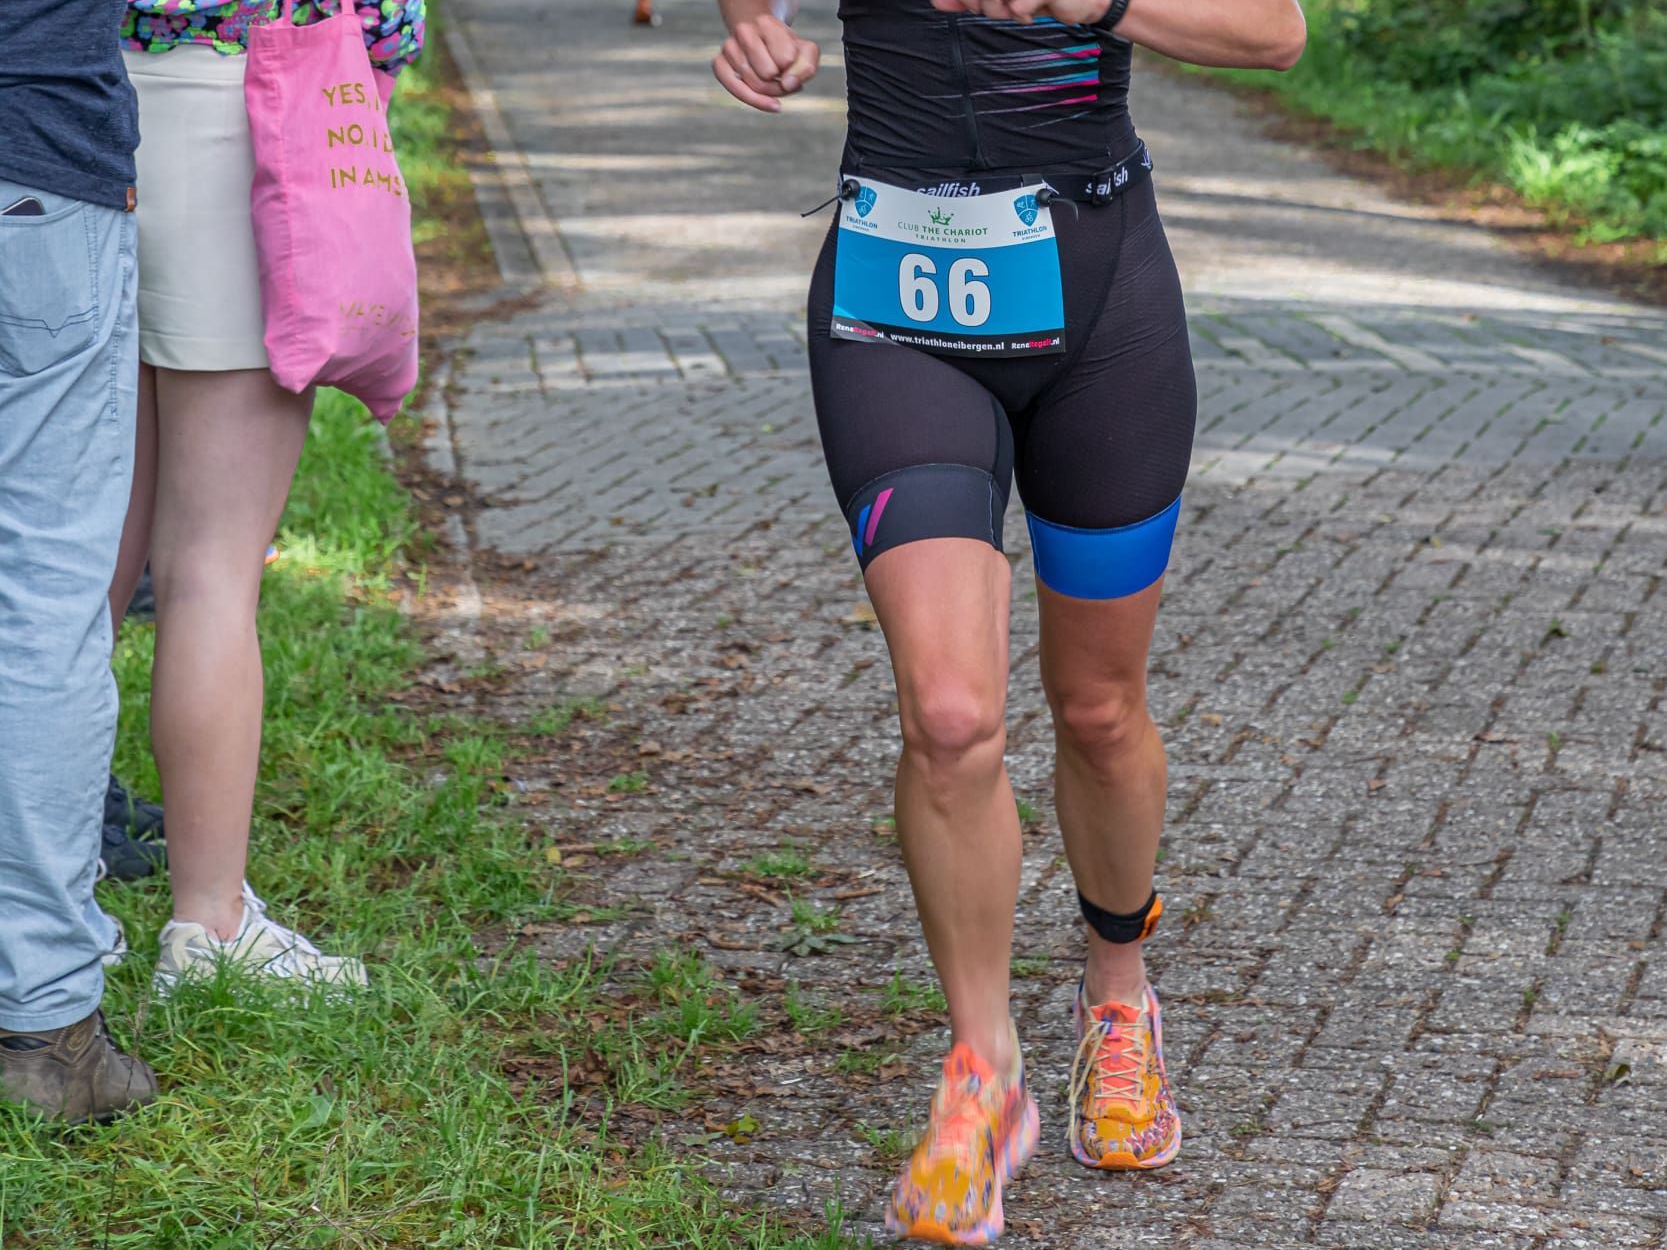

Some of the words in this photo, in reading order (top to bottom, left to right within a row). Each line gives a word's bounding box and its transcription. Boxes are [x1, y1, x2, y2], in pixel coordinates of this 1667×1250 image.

[331, 166, 356, 189] IN
[846, 216, 878, 229] TRIATHLON
[897, 221, 920, 232] CLUB
[922, 225, 941, 235] THE
[943, 228, 988, 237] CHARIOT
[915, 233, 966, 244] TRIATHLON
[1012, 226, 1048, 238] TRIATHLON
[899, 253, 991, 327] 66
[890, 333, 1005, 352] www.triathloneibergen.nl
